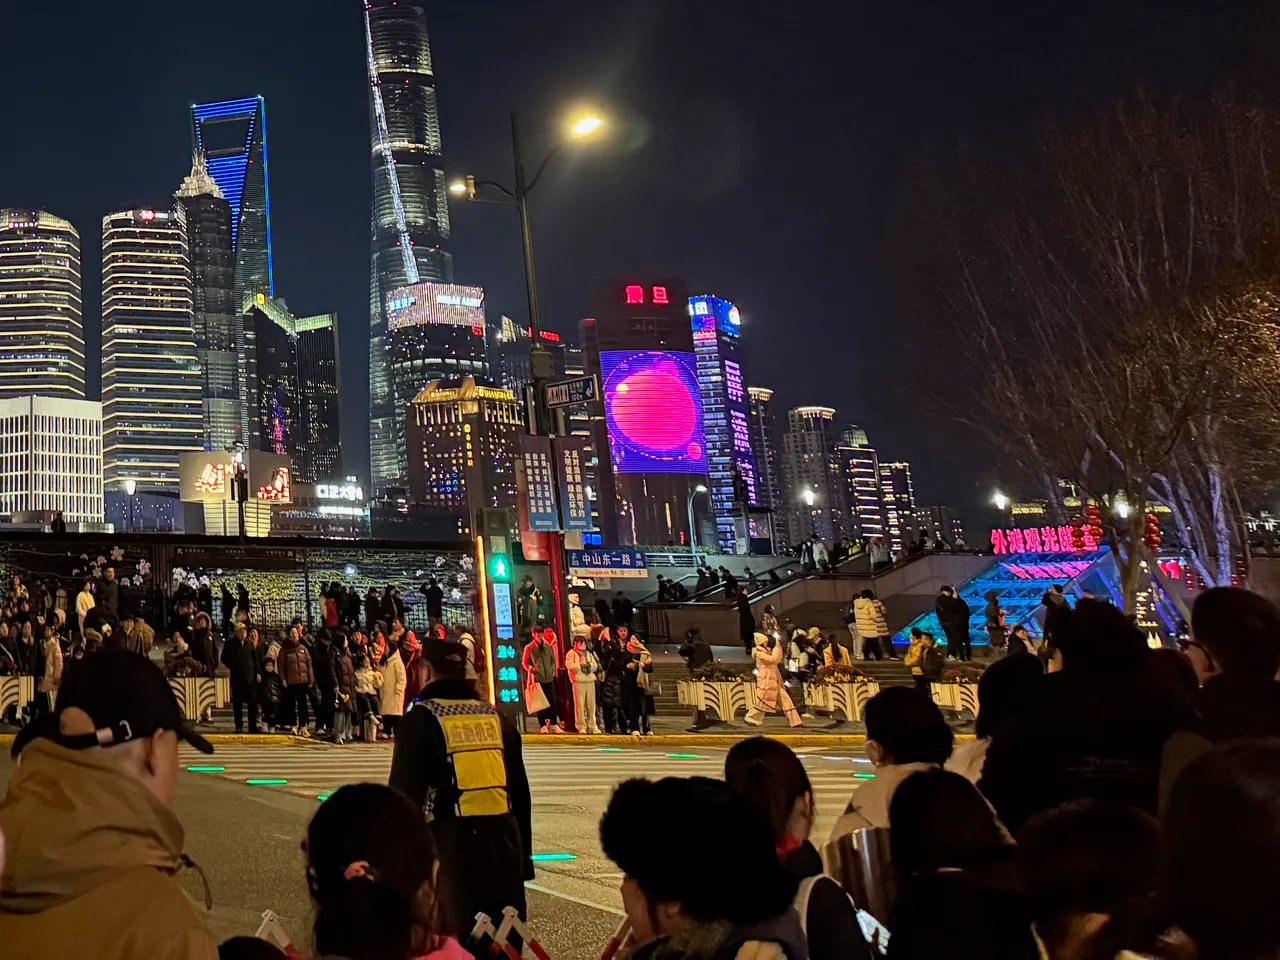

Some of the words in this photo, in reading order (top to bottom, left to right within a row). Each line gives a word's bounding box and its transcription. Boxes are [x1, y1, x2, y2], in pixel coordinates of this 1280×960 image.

[625, 285, 669, 304] 震旦
[582, 552, 631, 566] 中山东一路
